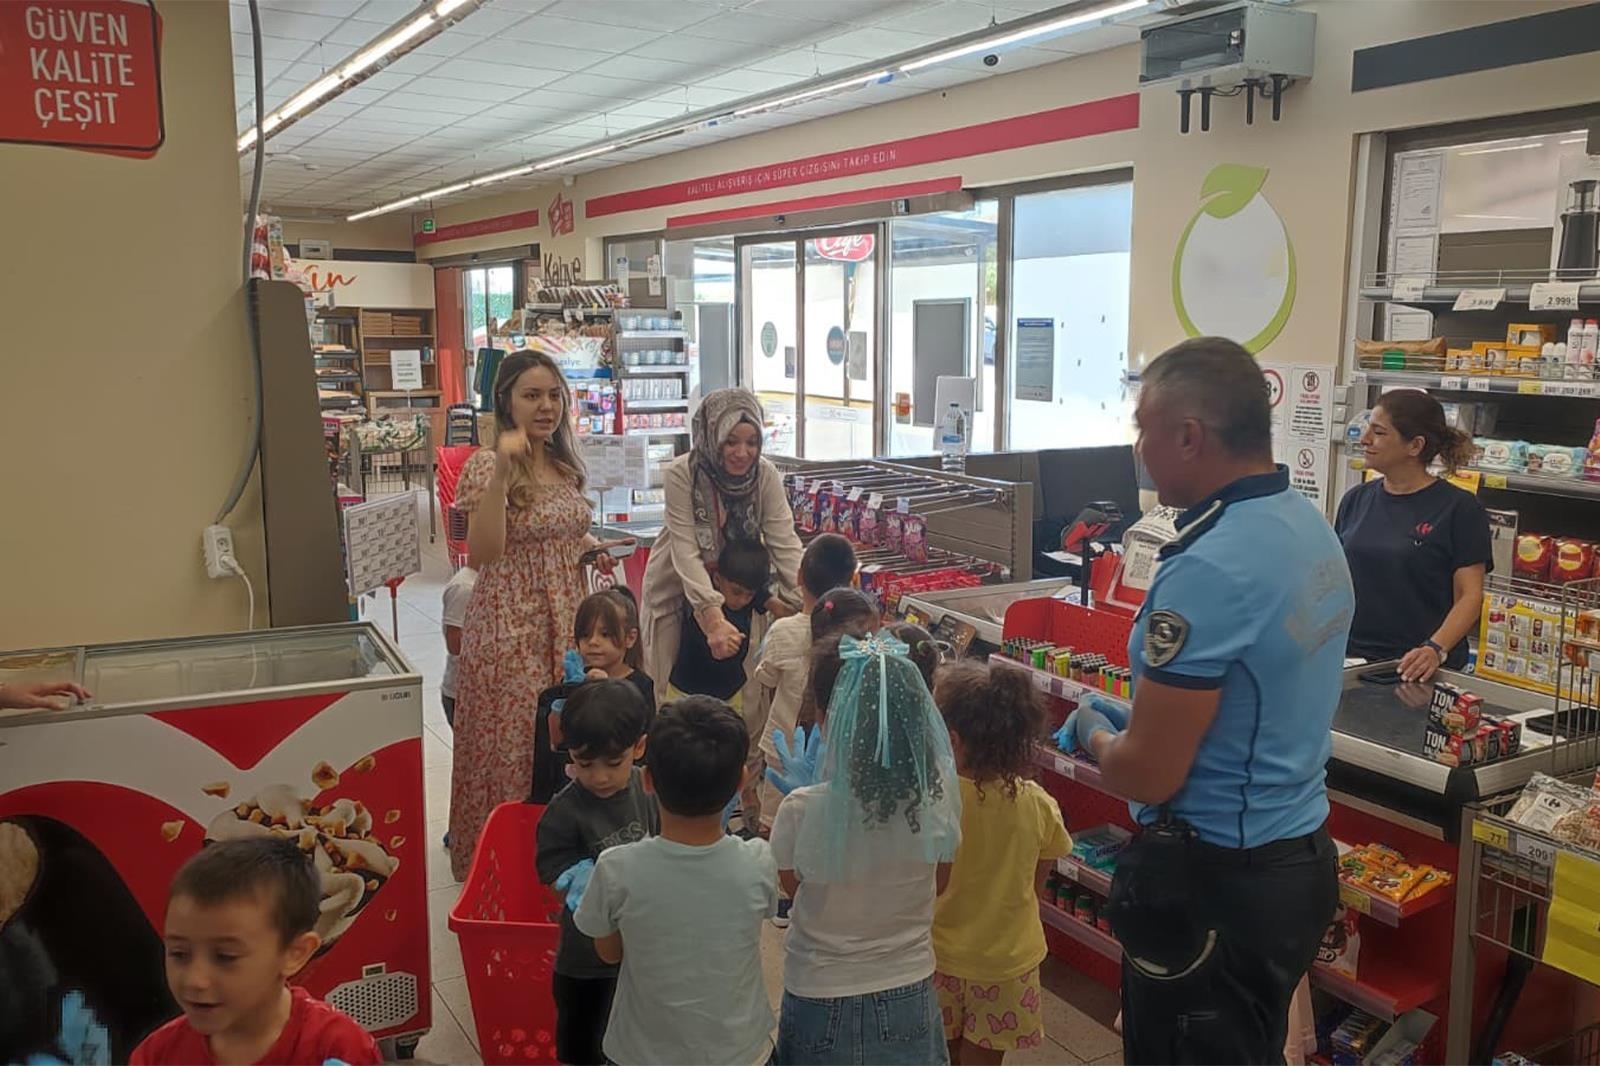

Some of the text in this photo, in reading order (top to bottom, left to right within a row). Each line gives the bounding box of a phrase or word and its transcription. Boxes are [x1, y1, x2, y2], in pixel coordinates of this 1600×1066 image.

[25, 6, 129, 47] GÜVEN
[1433, 690, 1455, 712] TON
[1426, 730, 1447, 753] TON
